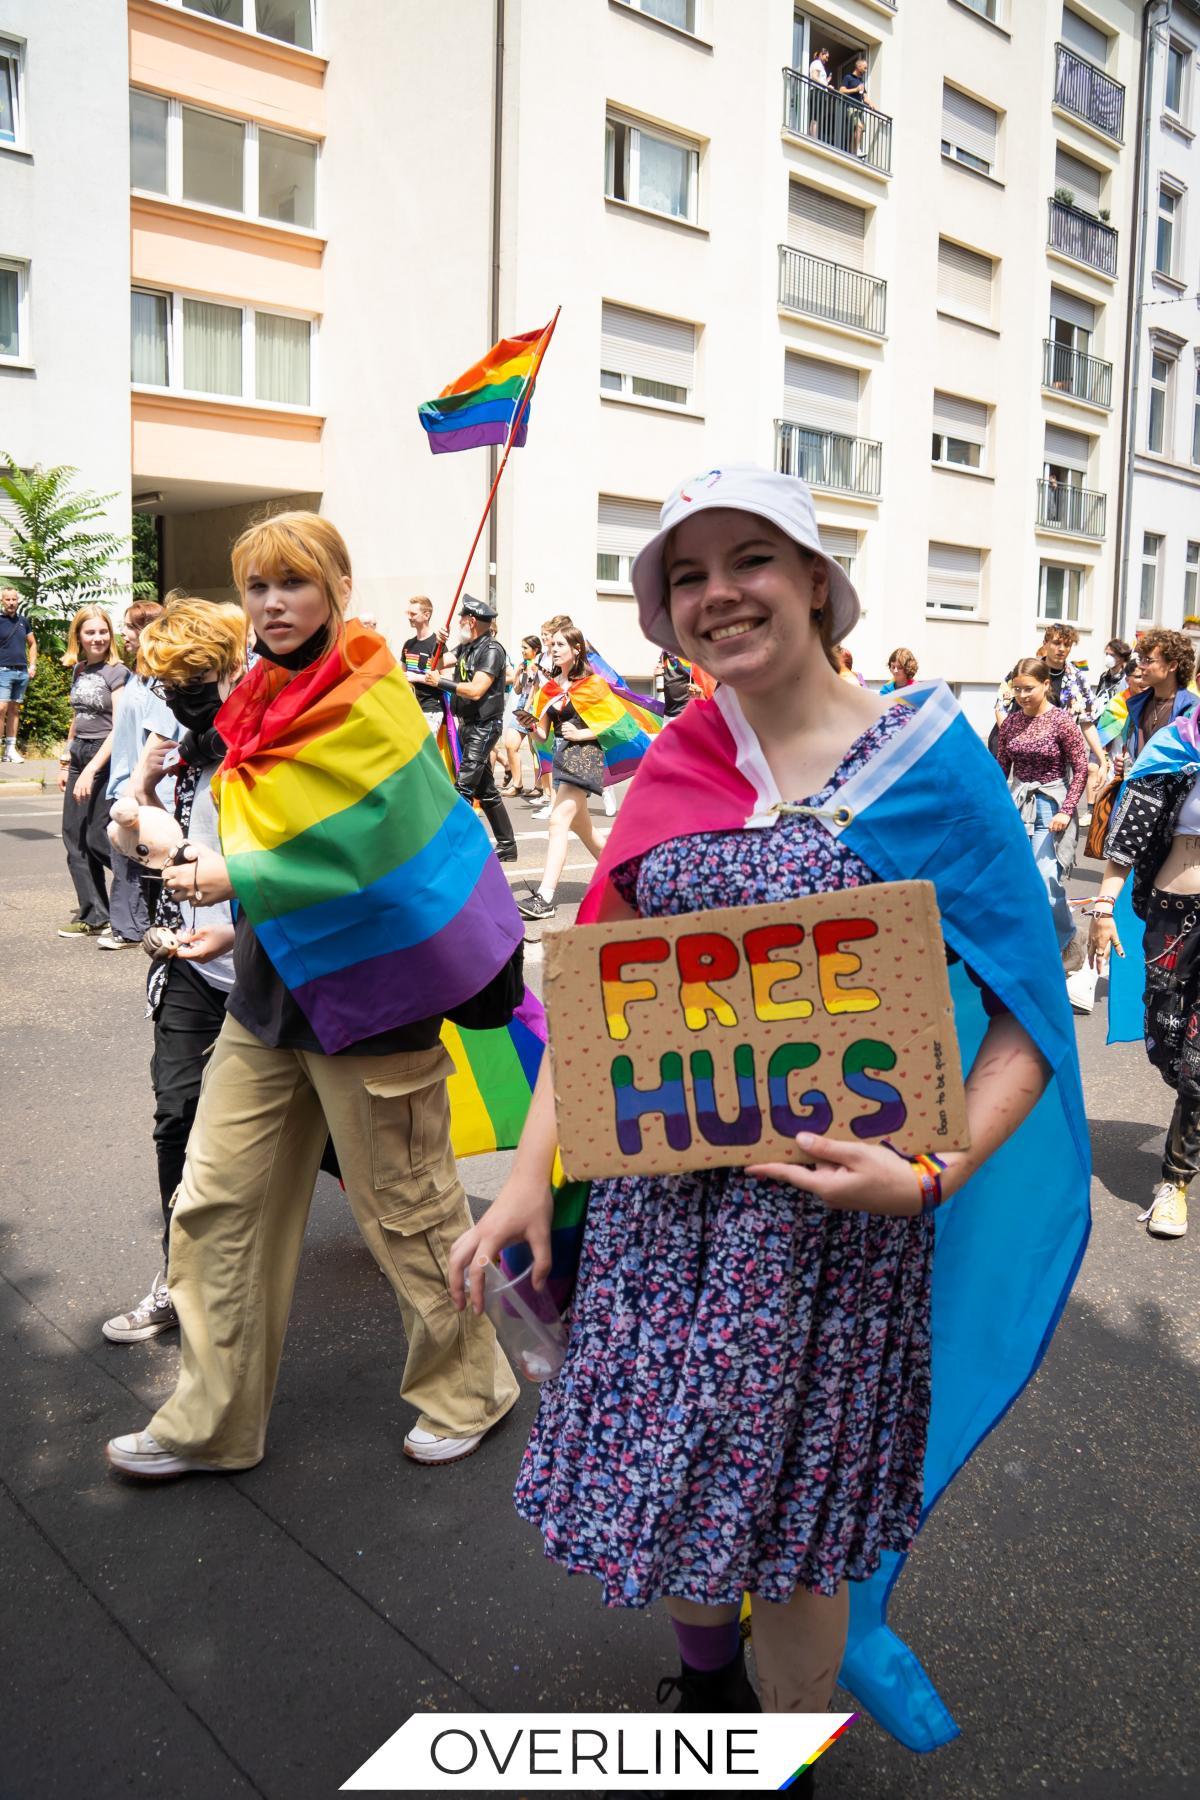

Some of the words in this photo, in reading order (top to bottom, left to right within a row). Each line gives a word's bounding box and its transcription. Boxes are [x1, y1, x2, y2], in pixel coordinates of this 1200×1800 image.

[524, 582, 535, 593] 30
[600, 917, 881, 1041] FREE
[933, 1040, 946, 1070] queer
[935, 1073, 945, 1090] be
[611, 1038, 907, 1156] HUGS
[935, 1091, 945, 1105] to
[937, 1109, 948, 1135] Born
